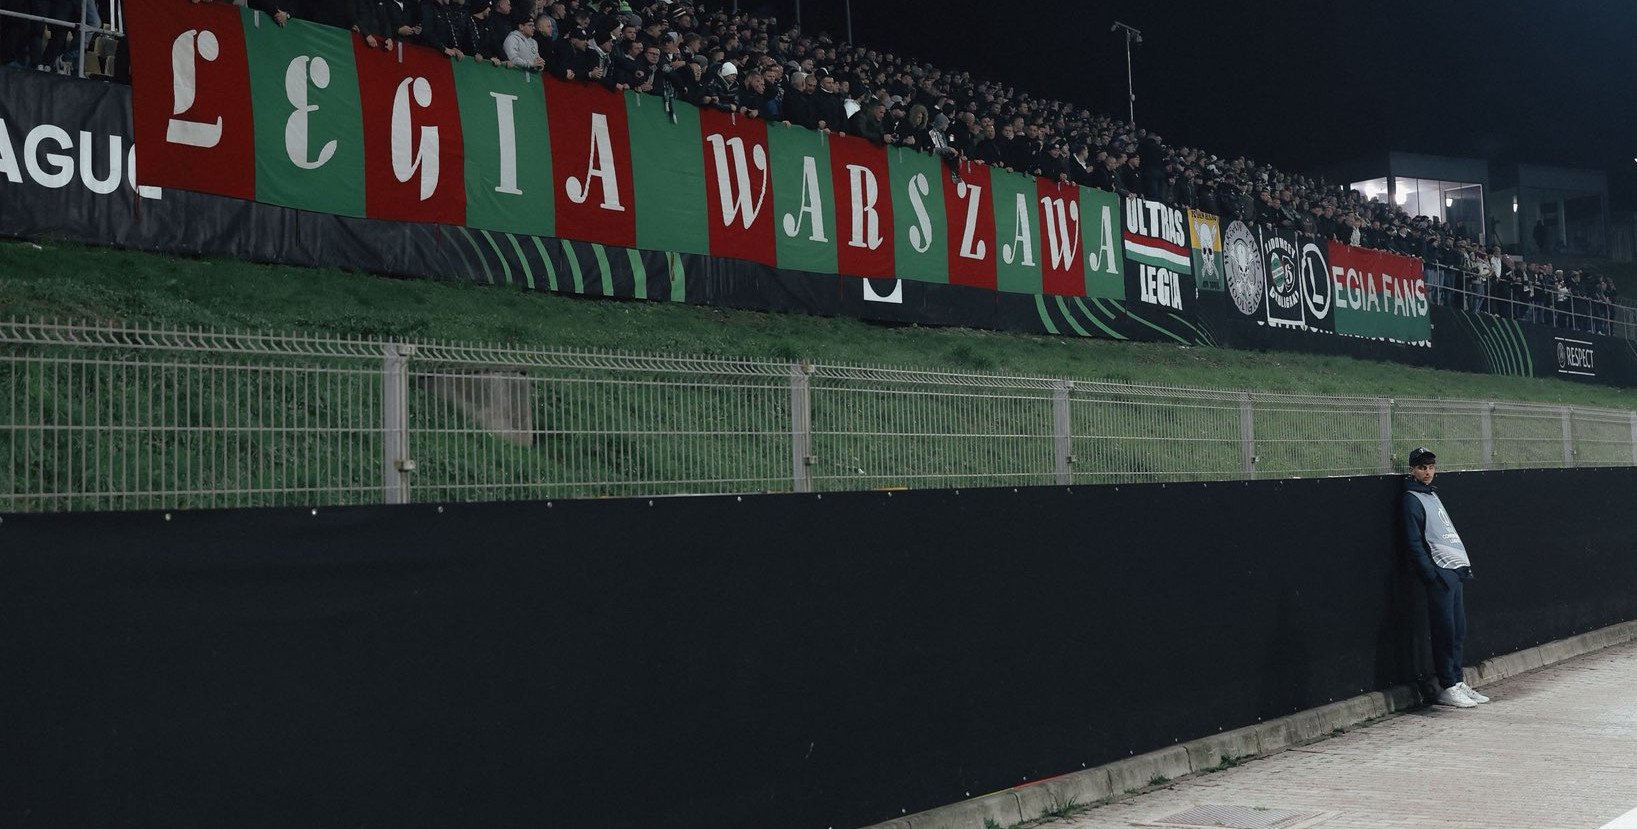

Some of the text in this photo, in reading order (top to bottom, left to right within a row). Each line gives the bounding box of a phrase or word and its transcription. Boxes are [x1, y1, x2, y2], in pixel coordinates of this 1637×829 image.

[166, 30, 1119, 275] LEGIA WARSZAWA
[1126, 197, 1185, 247] ULTRAS
[1140, 264, 1183, 310] LEGIA
[1382, 273, 1428, 317] FANS
[1566, 346, 1594, 368] RESPECT
